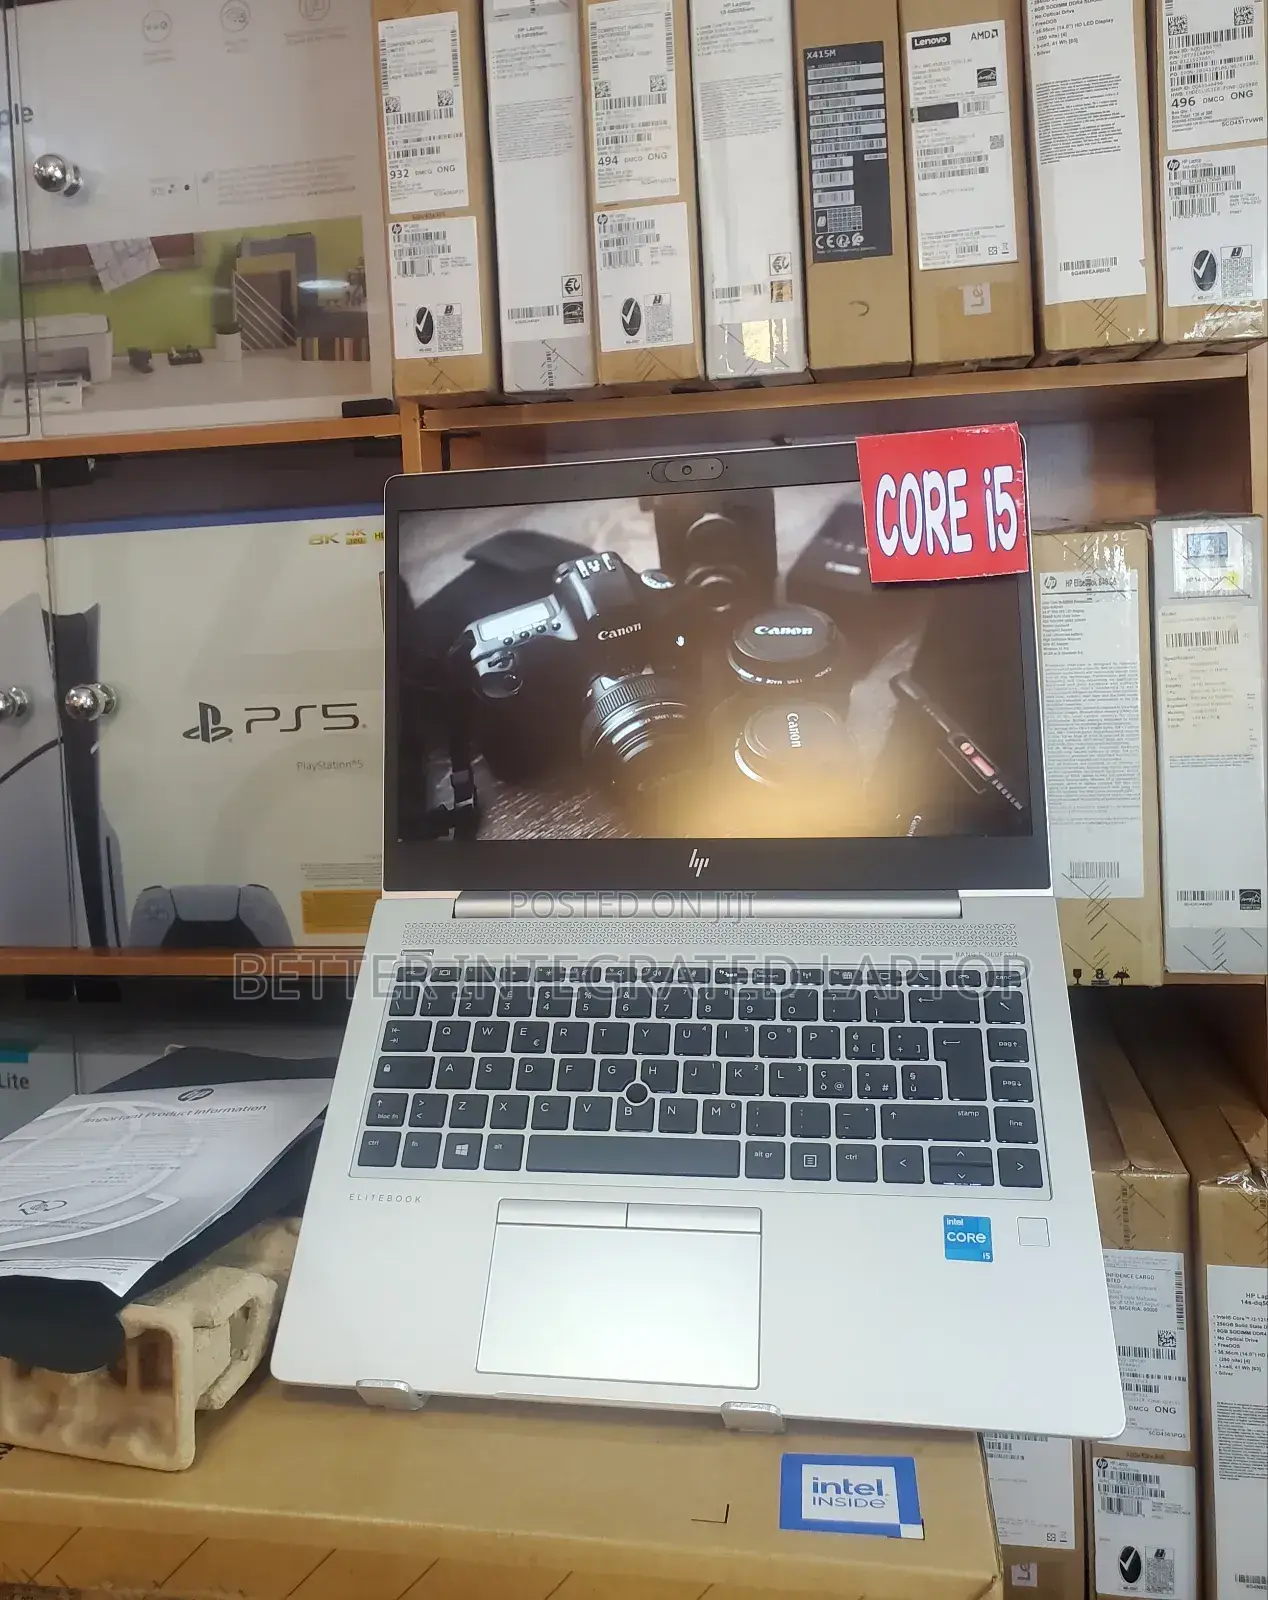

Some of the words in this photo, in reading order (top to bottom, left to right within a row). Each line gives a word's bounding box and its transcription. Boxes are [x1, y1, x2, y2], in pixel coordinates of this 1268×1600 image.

[914, 36, 948, 46] Lenovo
[970, 30, 991, 41] AMD
[806, 49, 836, 60] X415M
[1171, 96, 1196, 108] 496
[1230, 90, 1254, 100] ONG
[598, 156, 618, 166] 494
[648, 152, 668, 160] ONG
[390, 169, 409, 180] 932
[437, 165, 456, 173] ONG
[876, 468, 974, 557] CORE
[983, 465, 1018, 552] i5
[597, 622, 642, 641] Canon
[754, 625, 813, 636] Canon
[244, 703, 360, 734] PS5
[786, 713, 802, 748] Canon
[688, 848, 710, 878] hp
[482, 1027, 494, 1035] W
[834, 1082, 844, 1091] @
[84, 1113, 146, 1123] Important
[146, 1110, 192, 1118] Product
[349, 1194, 422, 1203] ELITEBOOK
[1155, 1406, 1176, 1414] ONG
[812, 1477, 884, 1496] intel
